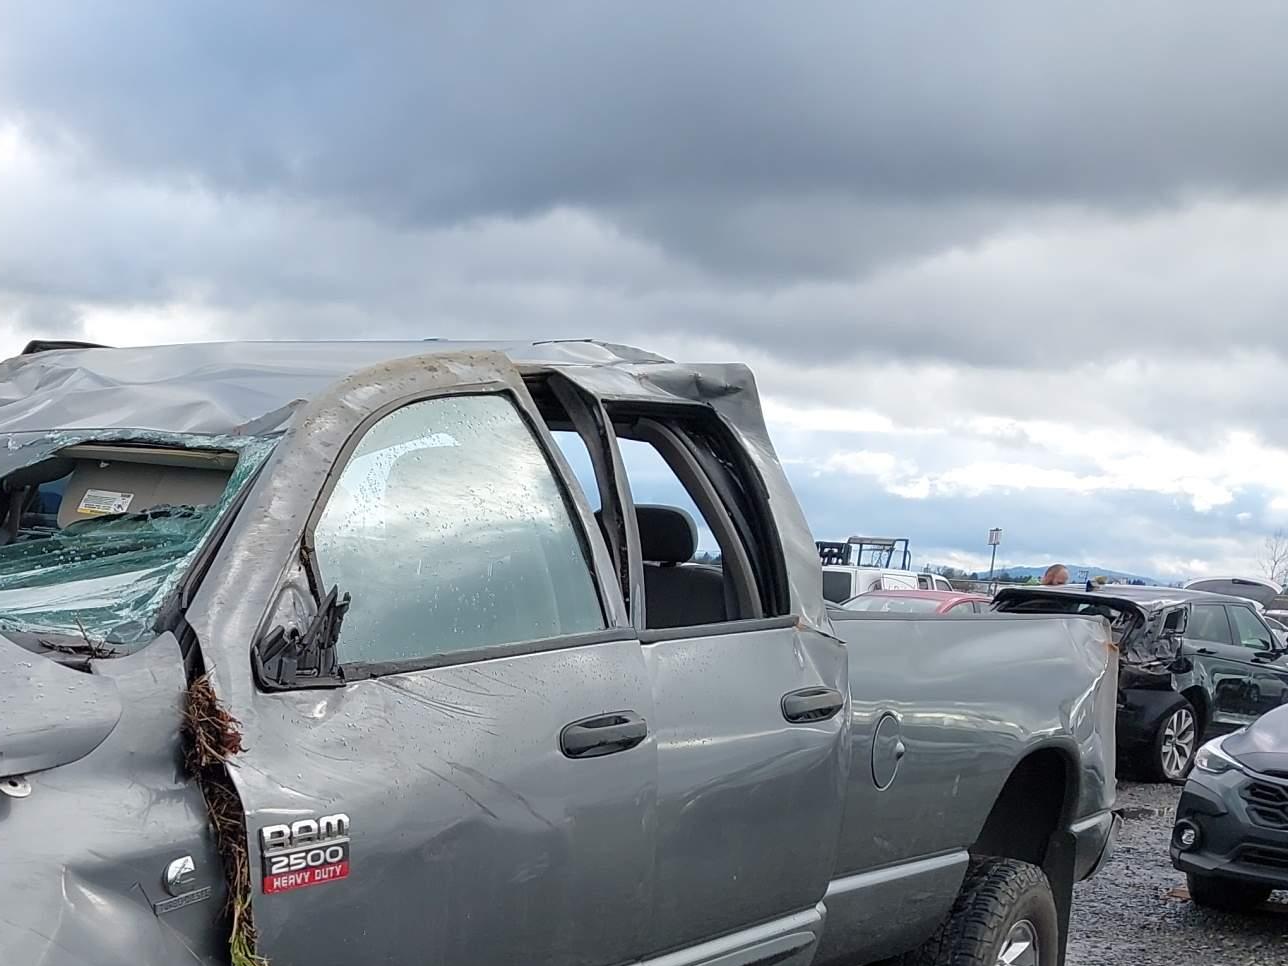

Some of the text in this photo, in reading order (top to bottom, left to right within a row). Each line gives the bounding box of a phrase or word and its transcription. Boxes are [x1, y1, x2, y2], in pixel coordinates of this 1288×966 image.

[271, 846, 344, 874] 2500
[273, 864, 343, 890] HEAVY DUTY
